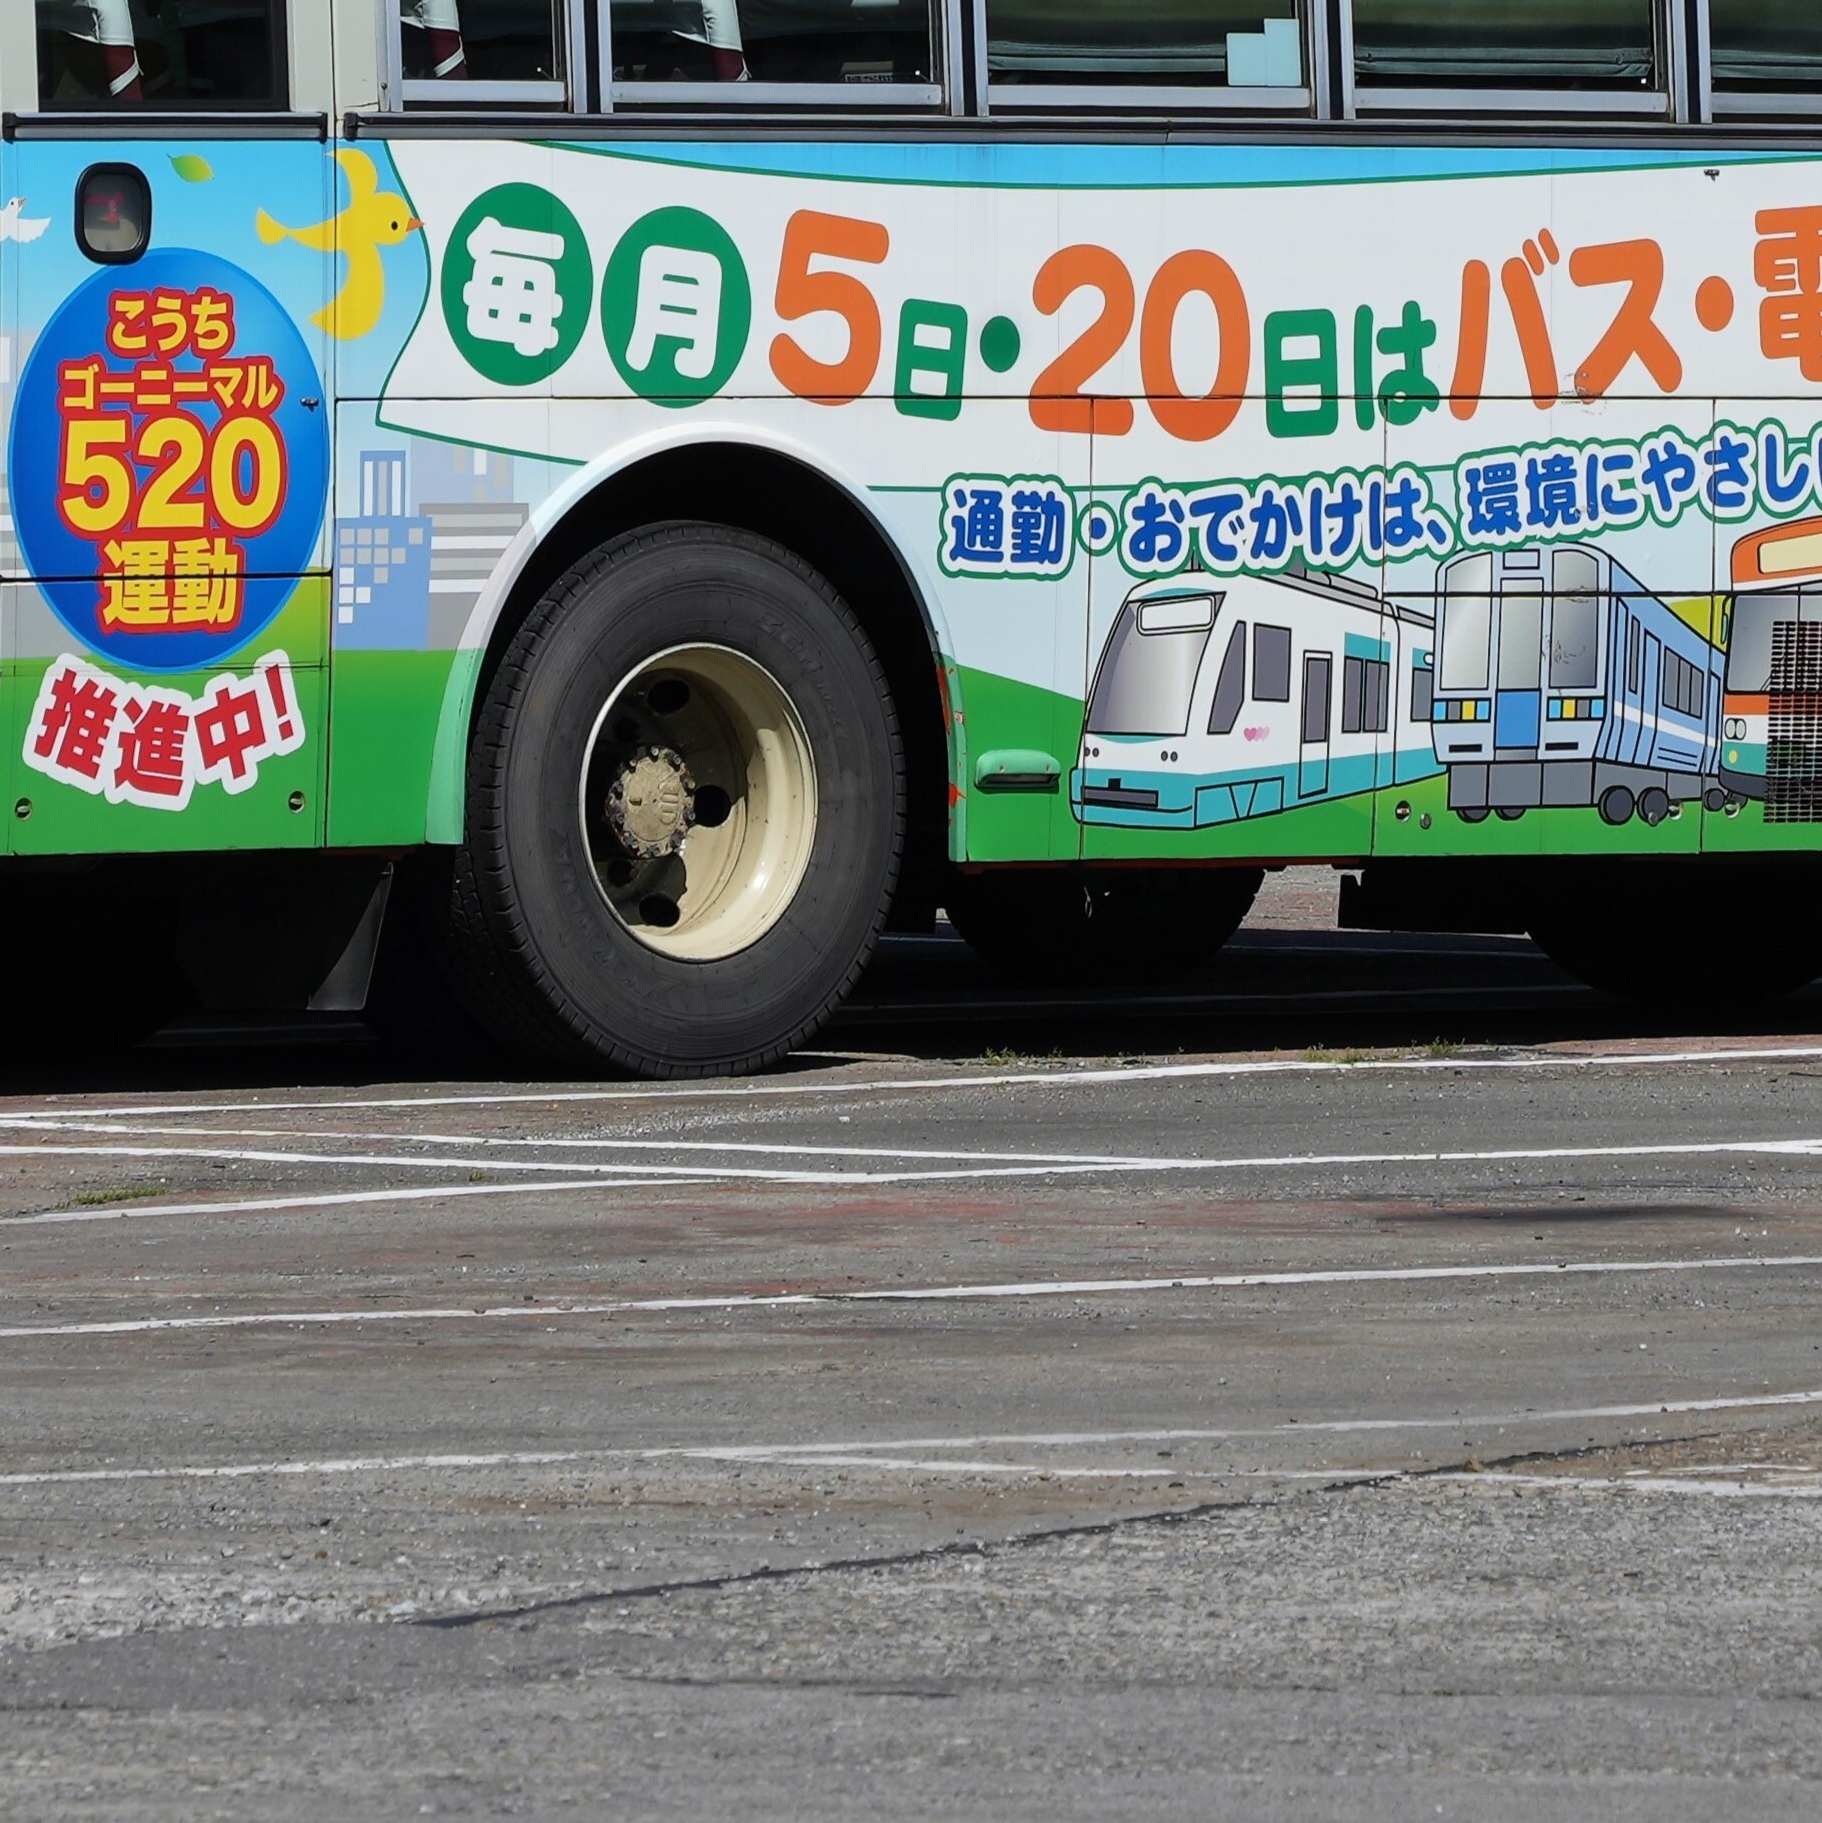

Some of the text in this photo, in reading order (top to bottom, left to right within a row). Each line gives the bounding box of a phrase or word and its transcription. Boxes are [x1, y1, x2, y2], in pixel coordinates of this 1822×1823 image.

[112, 294, 232, 354] こうち
[62, 363, 281, 411] ゴーニーマル
[62, 418, 282, 531] 520
[104, 539, 239, 625] 運動
